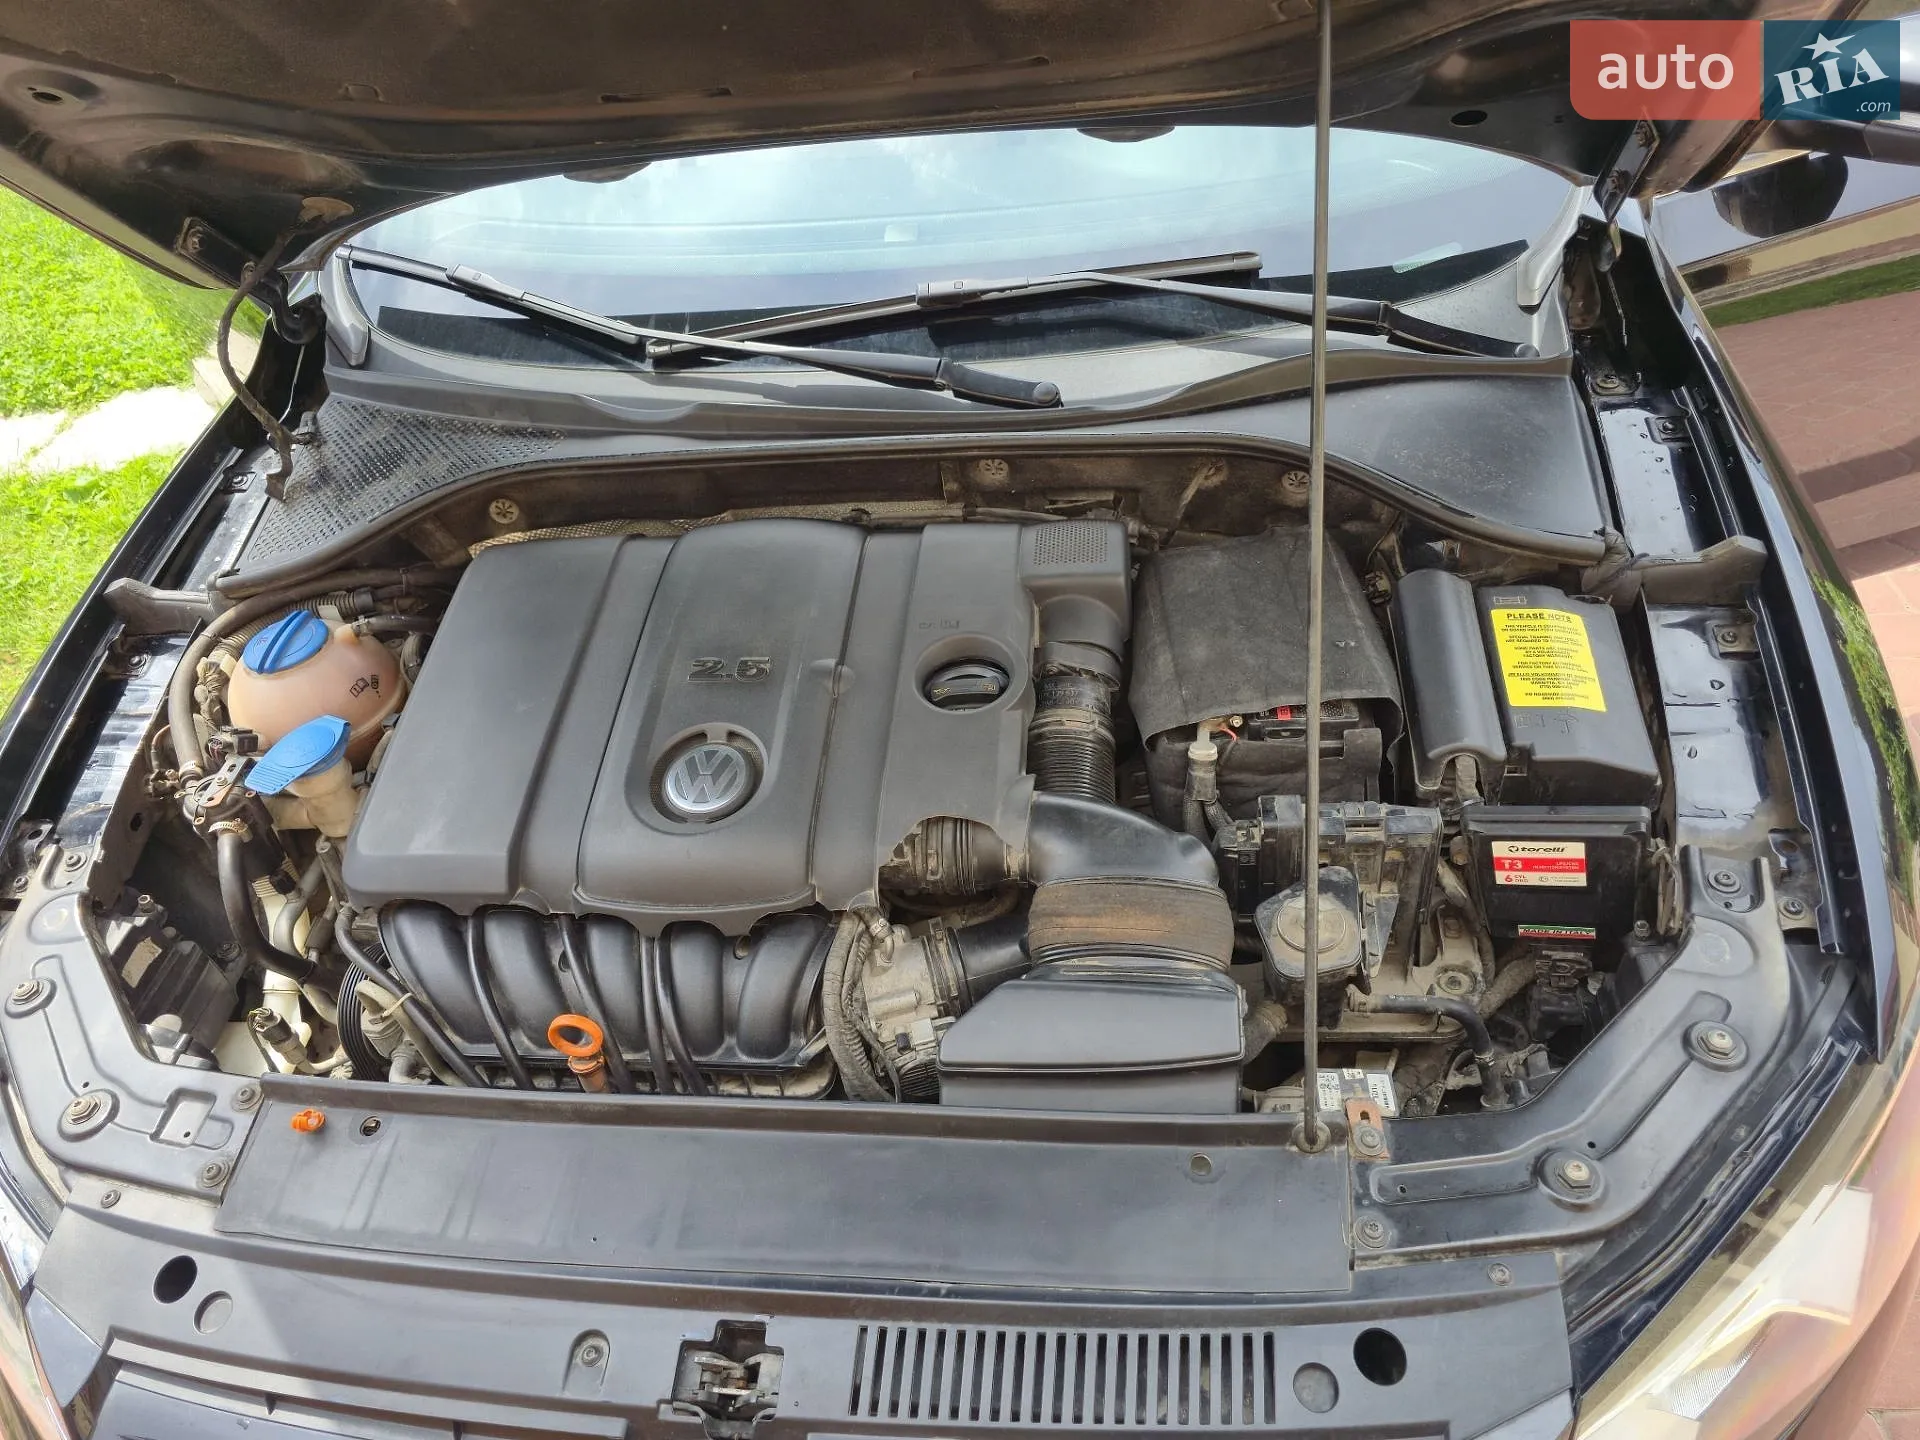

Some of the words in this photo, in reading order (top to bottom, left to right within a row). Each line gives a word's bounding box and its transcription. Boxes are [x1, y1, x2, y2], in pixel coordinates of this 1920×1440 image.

[1547, 613, 1572, 623] NOTE
[687, 656, 772, 683] 2.5
[1501, 859, 1523, 870] T3
[1504, 874, 1513, 883] 6
